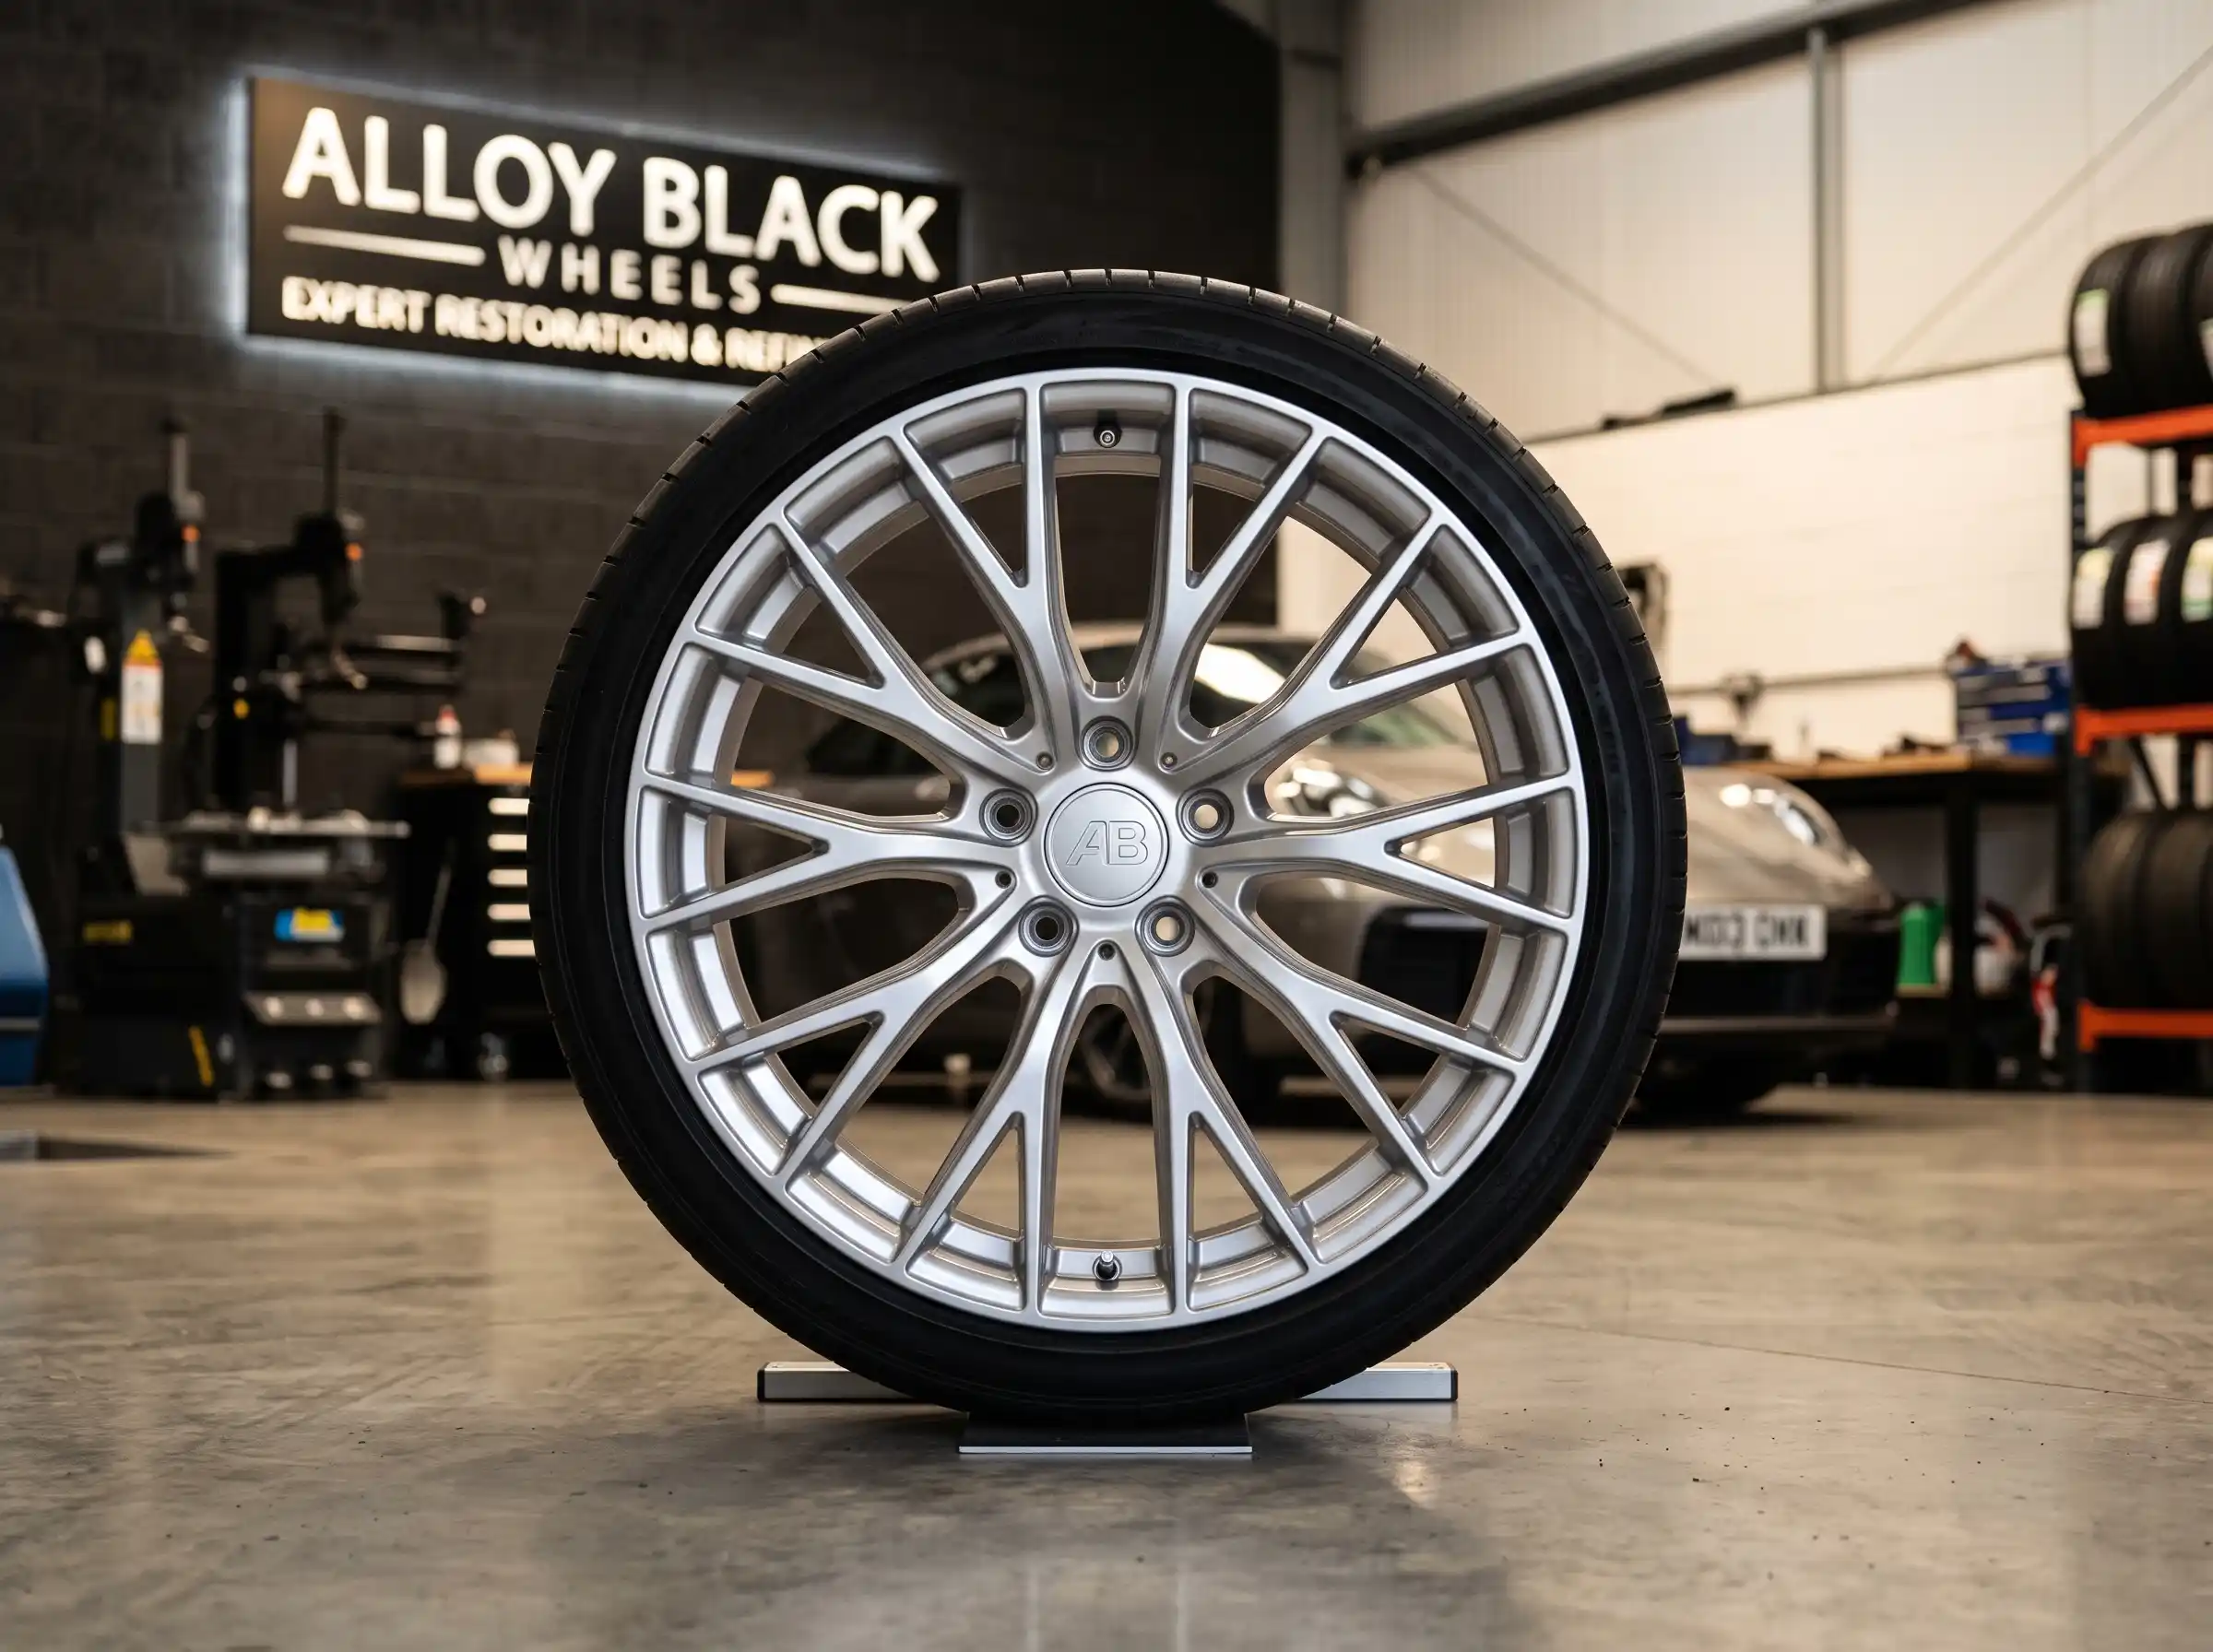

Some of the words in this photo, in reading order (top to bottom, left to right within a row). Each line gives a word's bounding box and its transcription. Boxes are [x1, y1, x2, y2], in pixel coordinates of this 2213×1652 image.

[281, 106, 617, 236] ALLOY
[643, 156, 939, 282] BLACK
[498, 236, 762, 314] WHEELS
[281, 276, 432, 333] EXPERT
[435, 293, 689, 362] RESTORATION
[690, 324, 723, 366] &
[1066, 820, 1149, 866] AB
